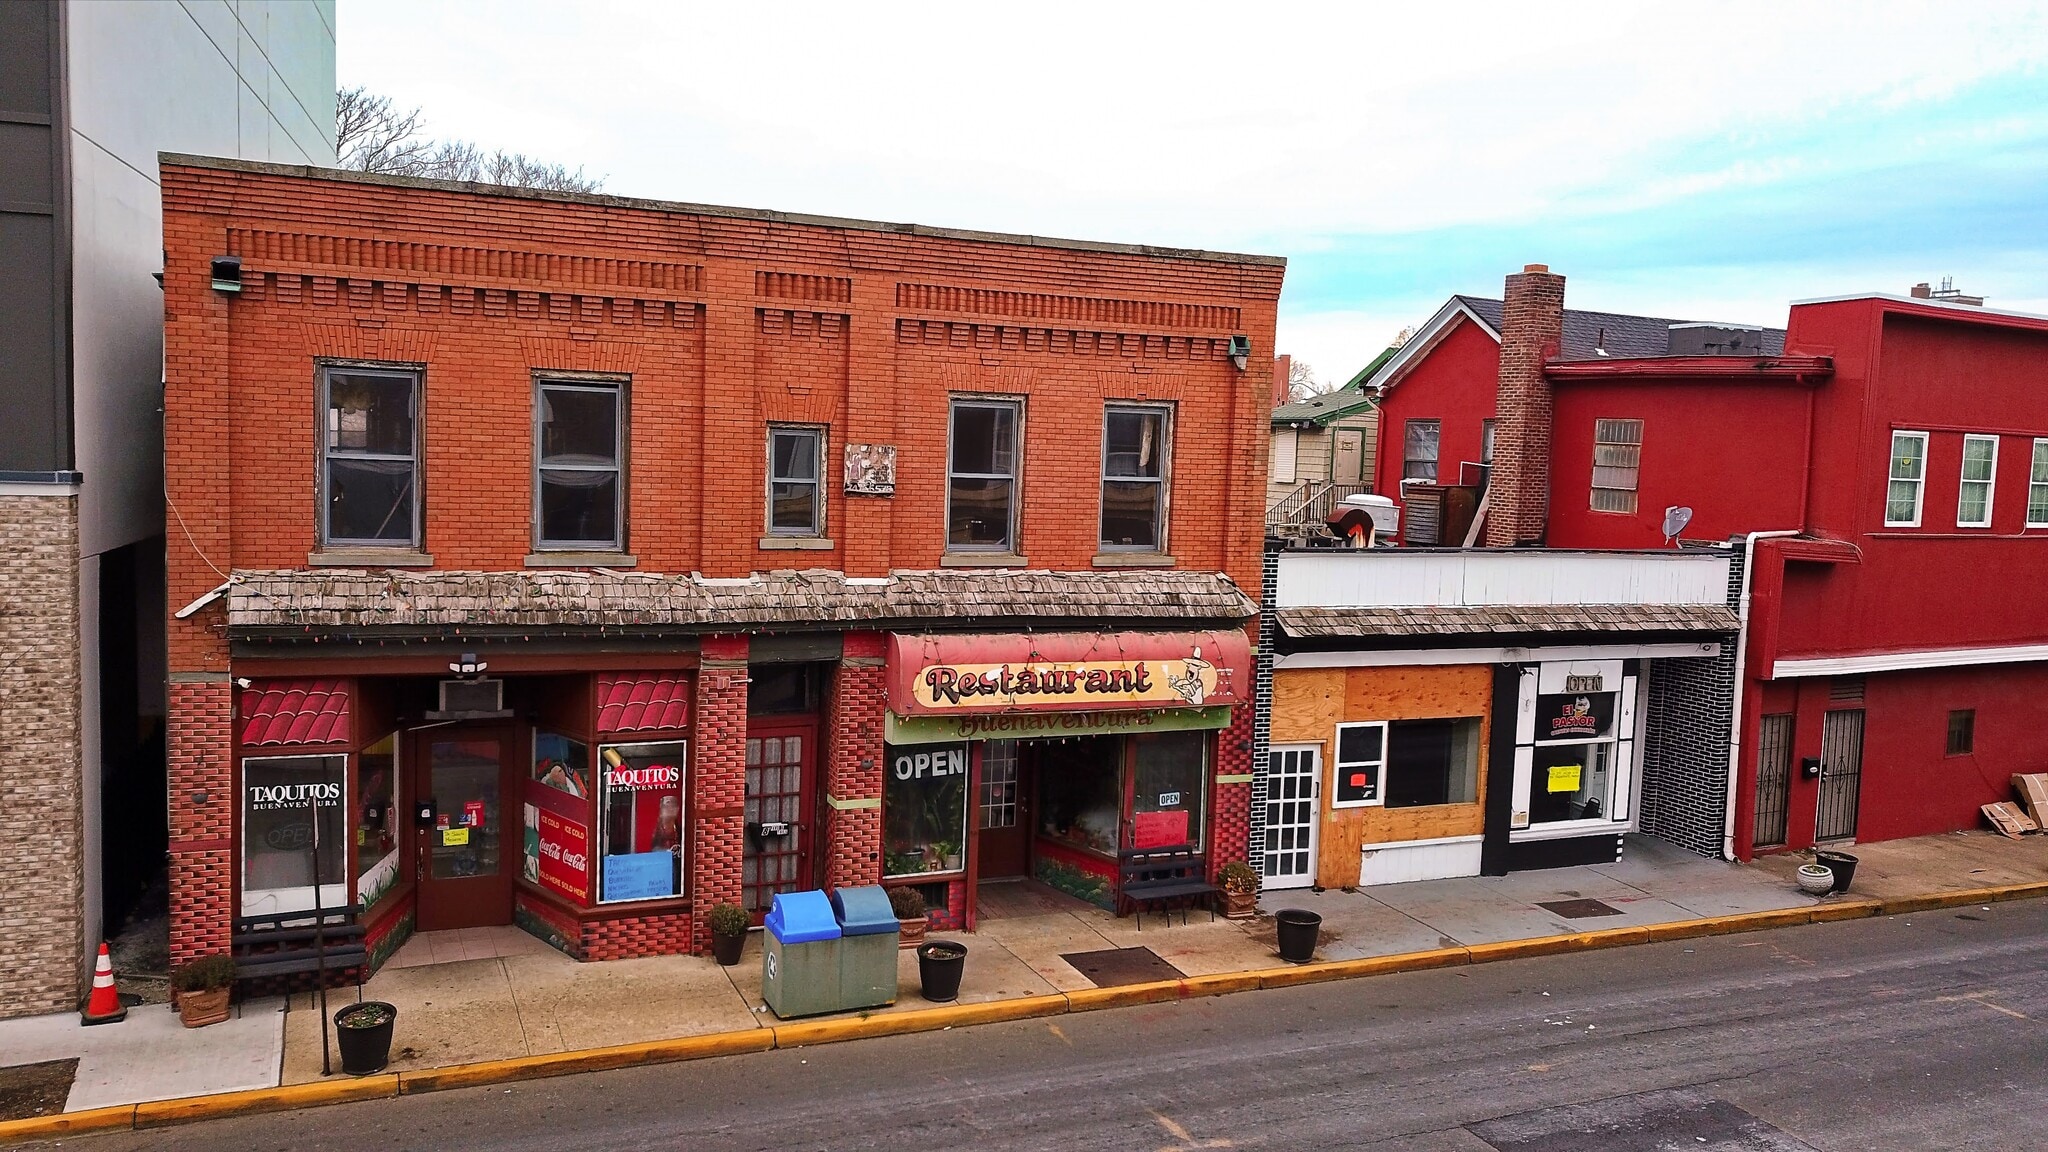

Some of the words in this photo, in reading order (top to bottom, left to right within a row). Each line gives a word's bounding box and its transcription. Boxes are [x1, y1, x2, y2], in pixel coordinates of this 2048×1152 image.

[926, 661, 1153, 704] Restaurant
[1570, 677, 1602, 691] OPEN
[1552, 716, 1596, 728] PASTOR
[895, 749, 964, 780] OPEN
[604, 767, 679, 787] TAQUITOS
[249, 782, 340, 803] TAQUITOS
[1160, 794, 1179, 805] OPEN
[253, 800, 337, 810] BUENAVENURA
[547, 818, 560, 829] COLD
[564, 825, 572, 834] ICE
[571, 828, 585, 840] COLD
[549, 875, 561, 887] HERE
[561, 881, 573, 893] SOLD
[573, 887, 587, 899] HERE
